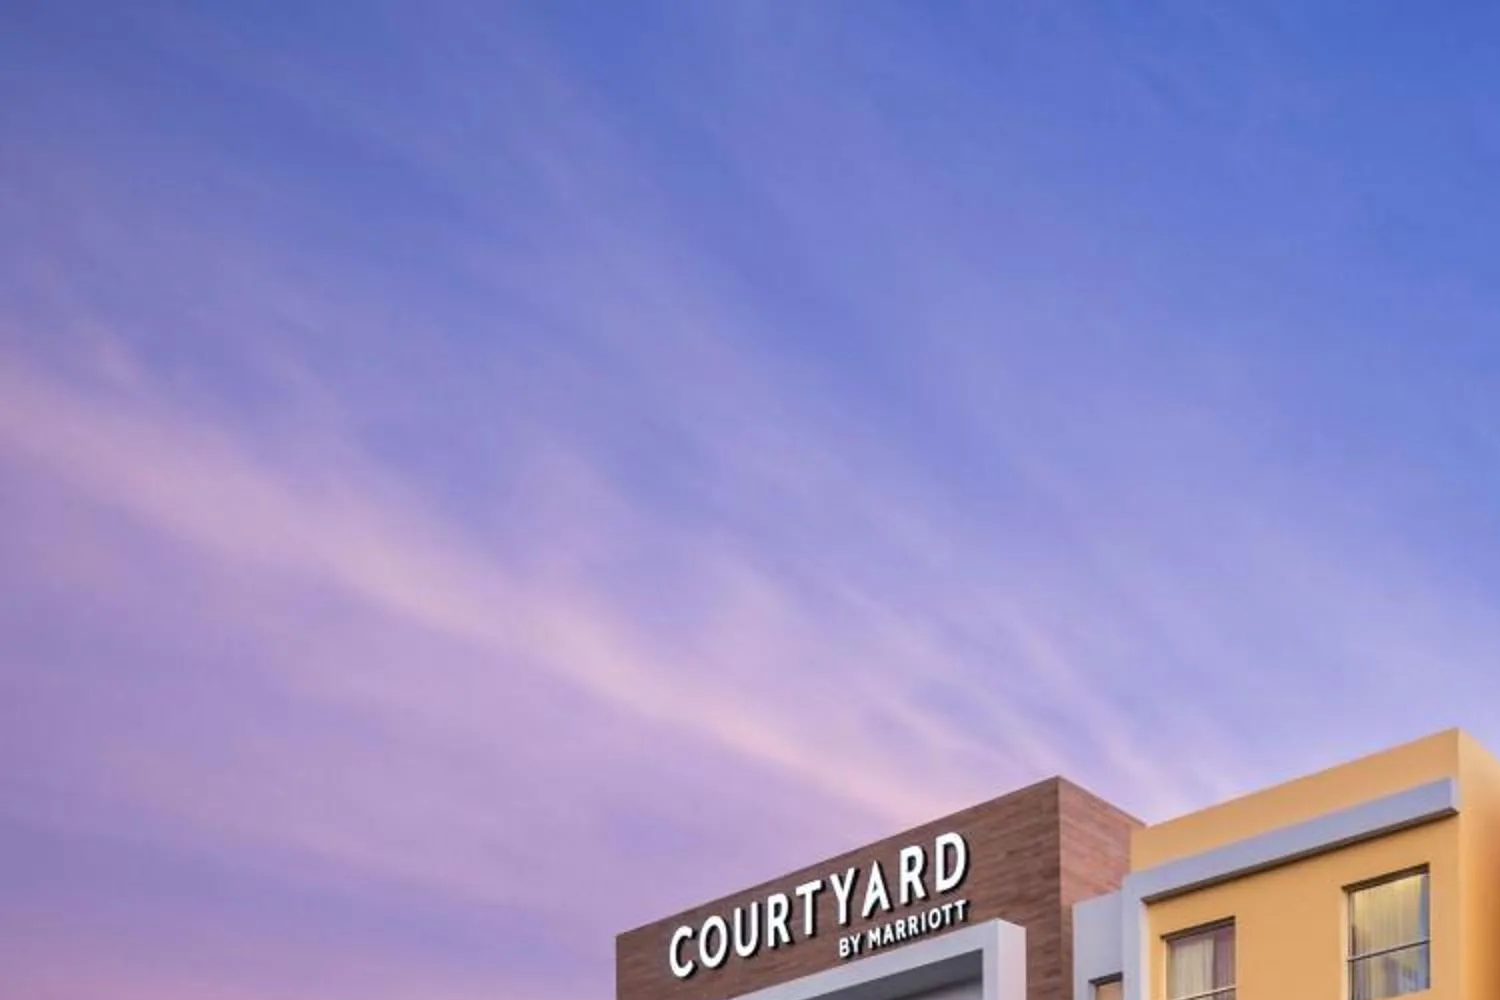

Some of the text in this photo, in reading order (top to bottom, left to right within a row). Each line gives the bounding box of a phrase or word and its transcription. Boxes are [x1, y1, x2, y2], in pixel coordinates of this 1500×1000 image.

[669, 831, 967, 979] COURTYARD
[839, 899, 968, 958] BY MARRIOTT
